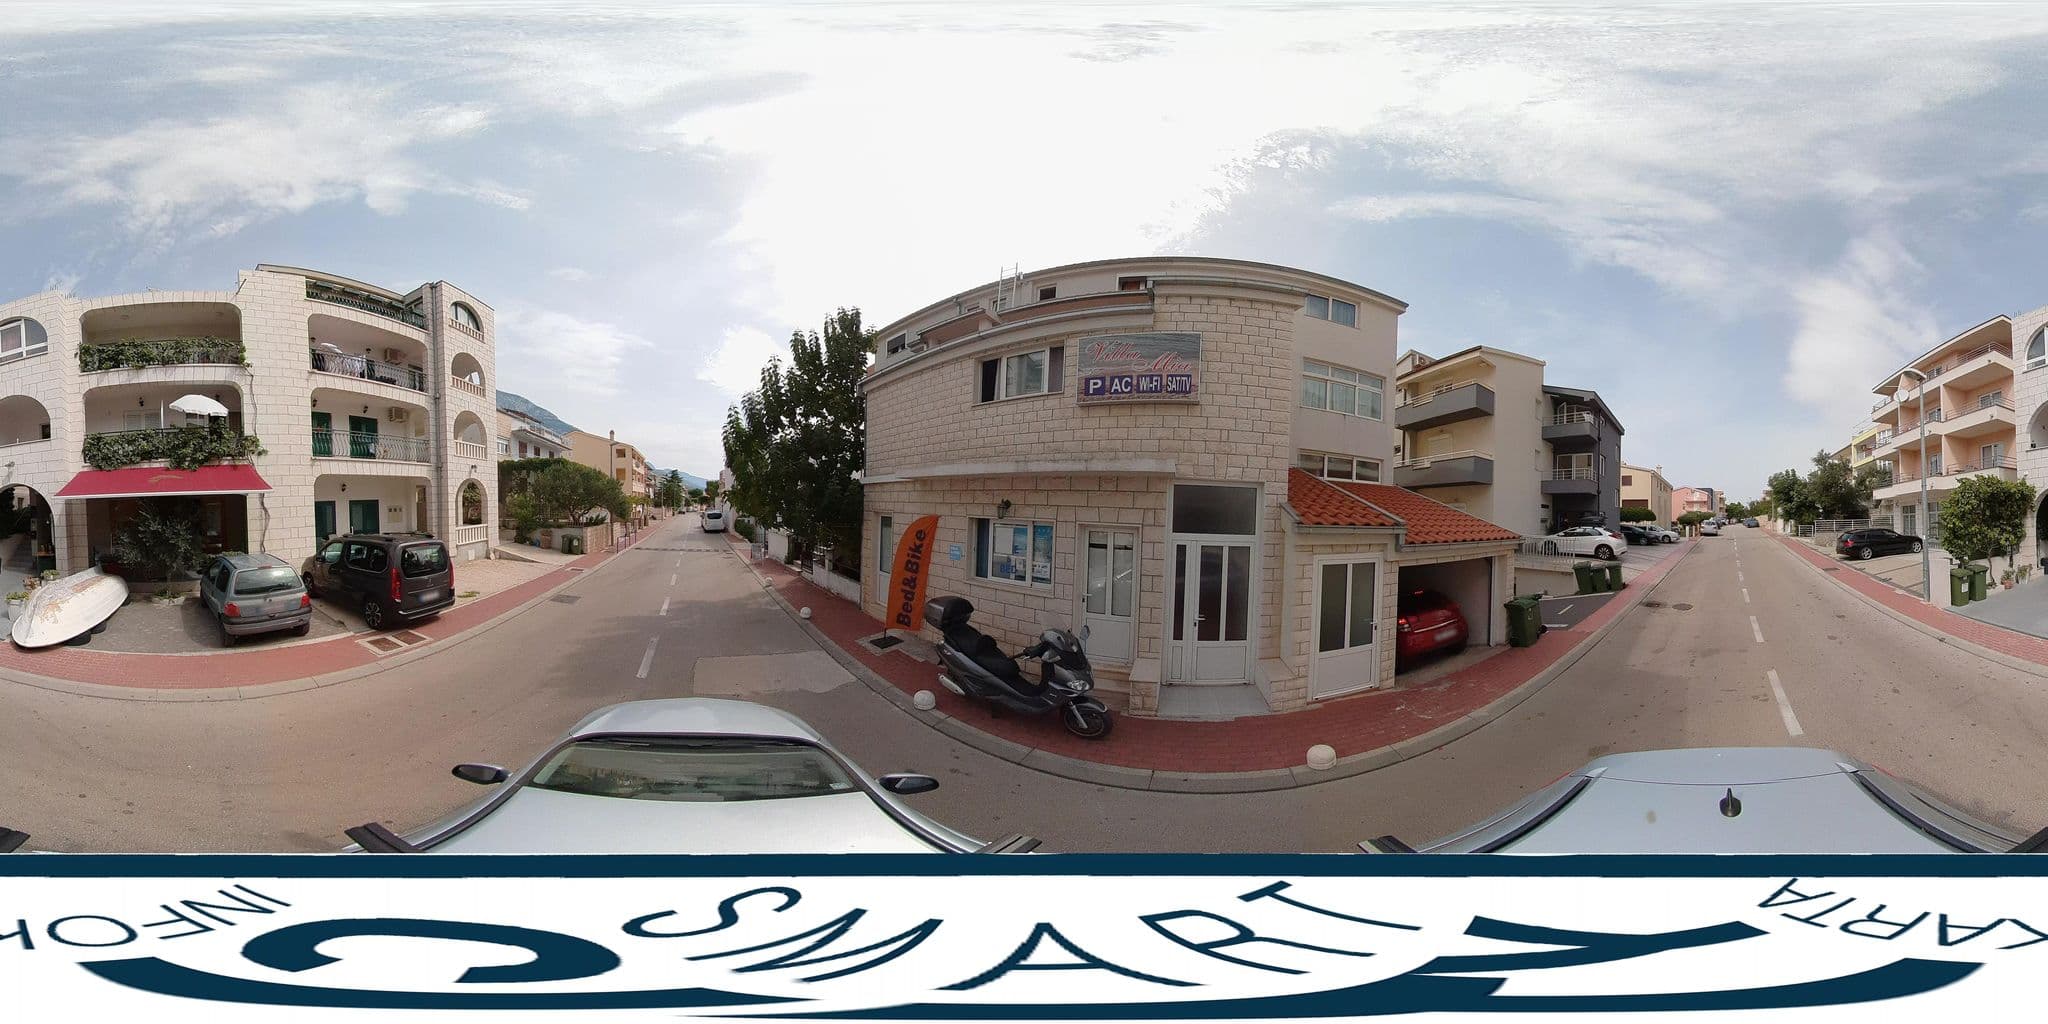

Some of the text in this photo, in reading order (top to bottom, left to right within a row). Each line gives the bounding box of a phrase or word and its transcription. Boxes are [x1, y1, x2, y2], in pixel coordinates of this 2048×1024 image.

[1089, 376, 1191, 394] P AC WI-FI SAT/TV
[896, 529, 927, 627] Bed&Bike
